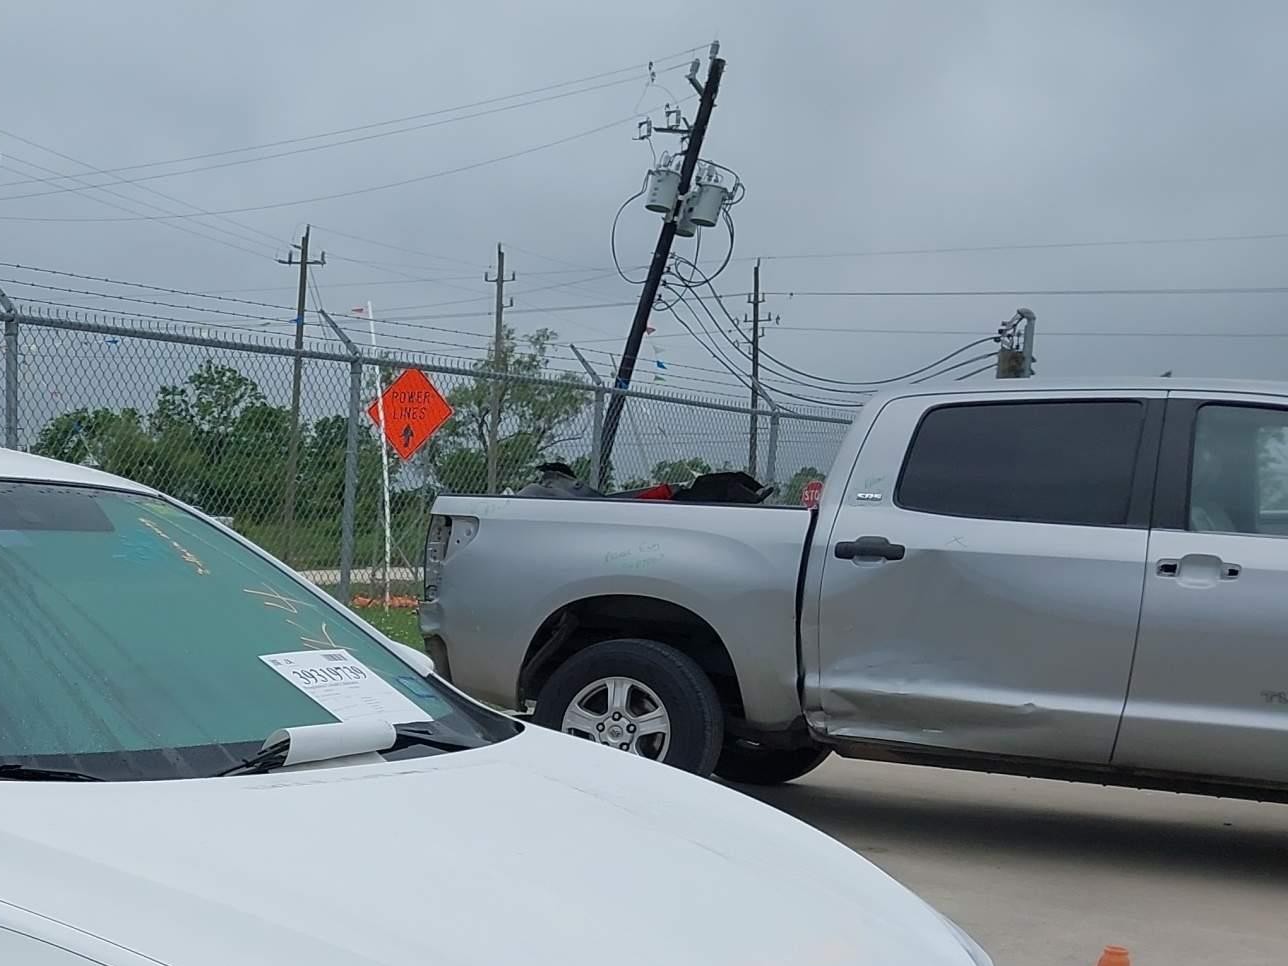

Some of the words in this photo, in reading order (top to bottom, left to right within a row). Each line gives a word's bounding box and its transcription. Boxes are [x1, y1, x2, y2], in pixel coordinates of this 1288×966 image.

[392, 391, 431, 404] POWER
[392, 406, 427, 420] LINES
[292, 665, 368, 685] 39319739
